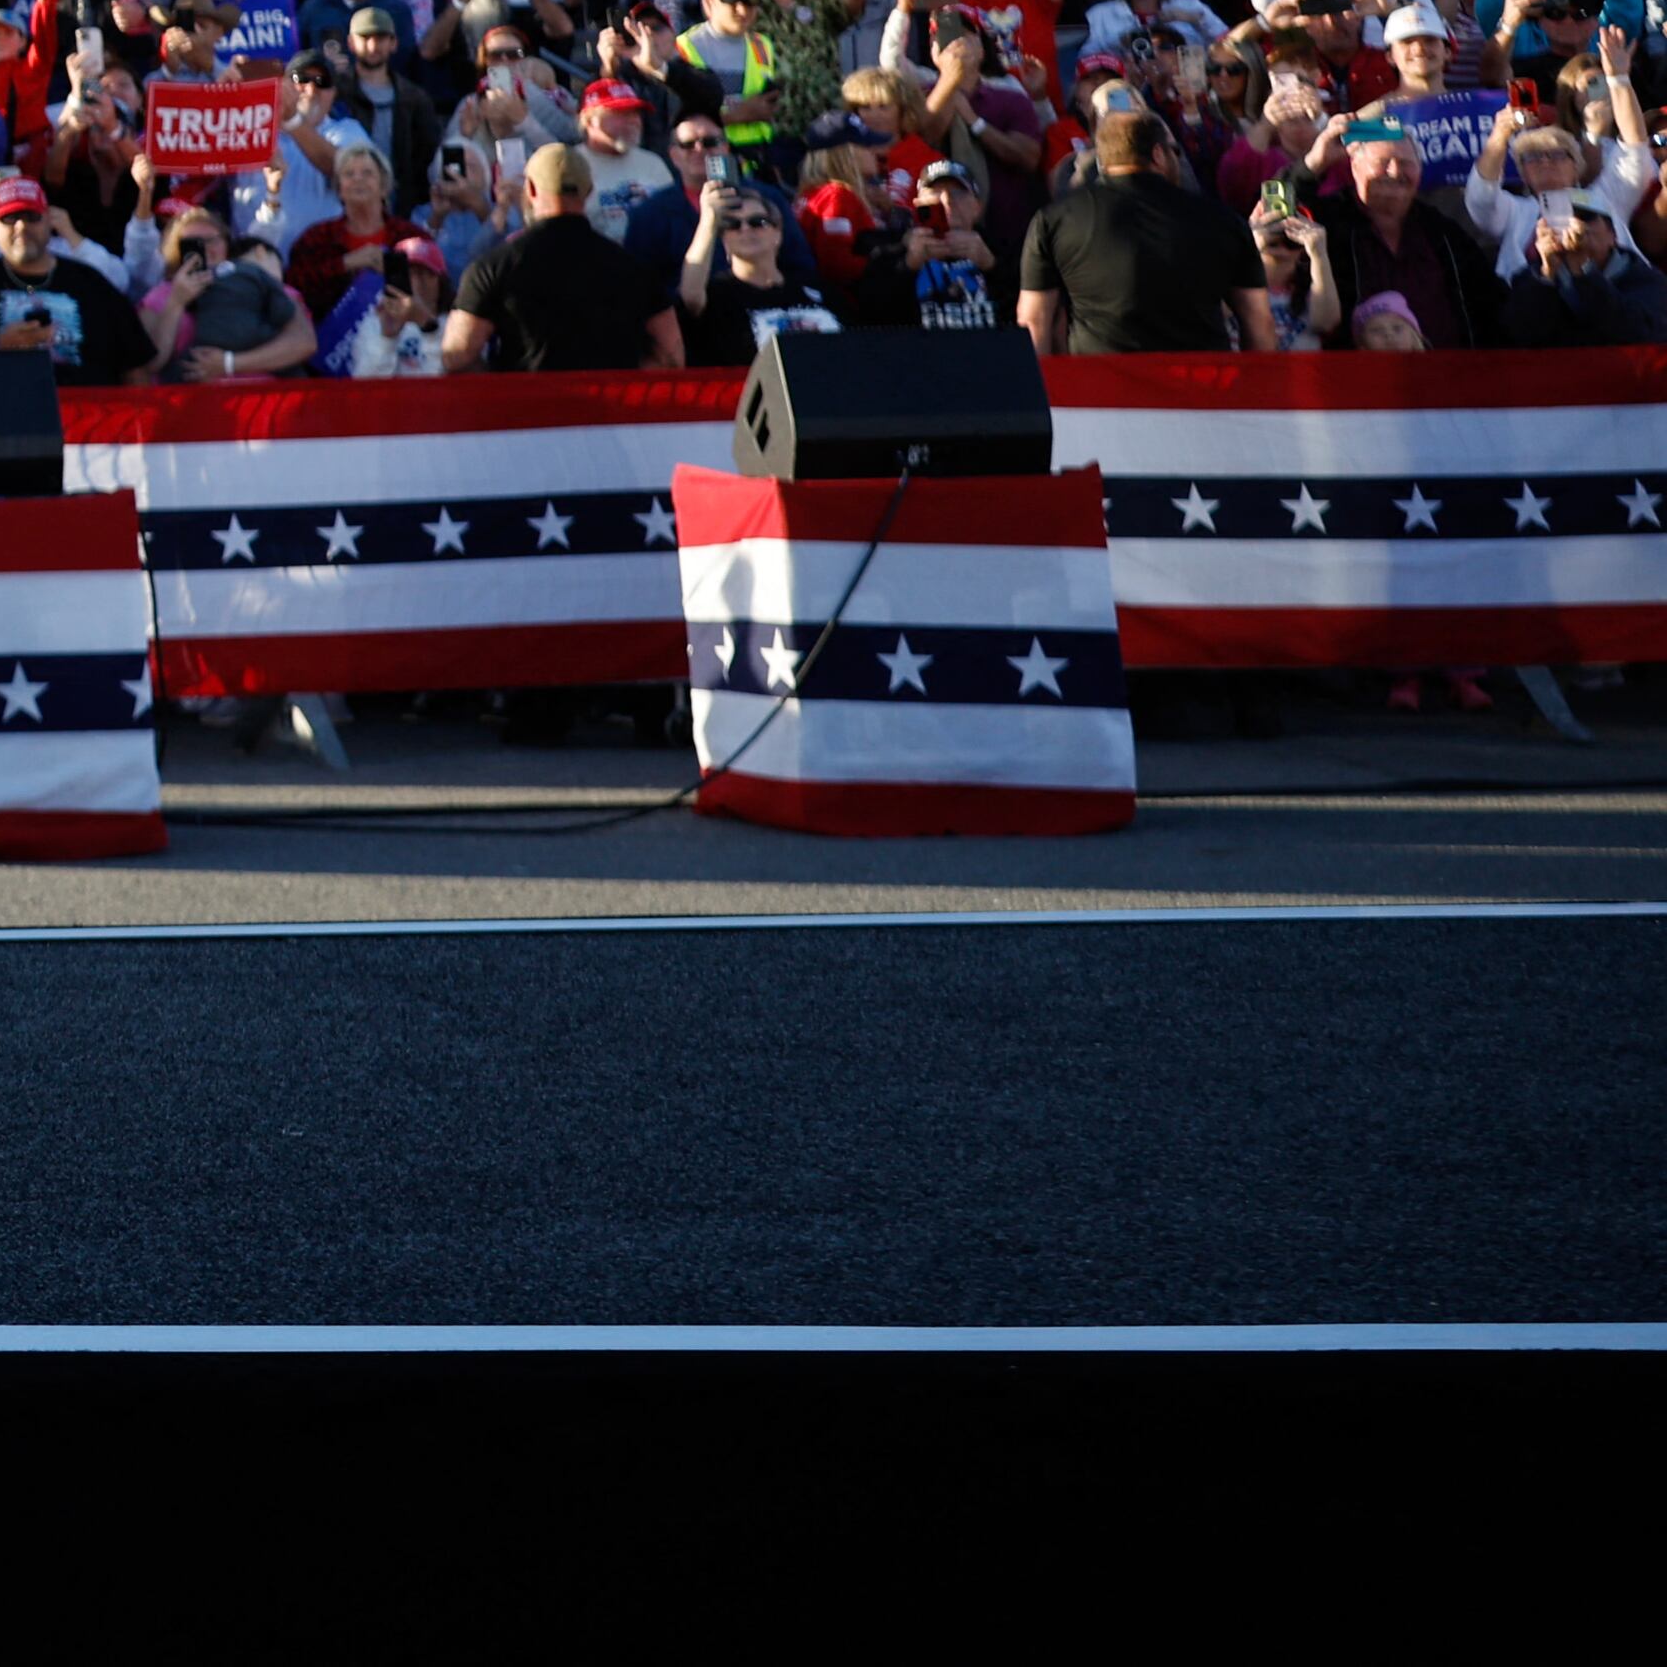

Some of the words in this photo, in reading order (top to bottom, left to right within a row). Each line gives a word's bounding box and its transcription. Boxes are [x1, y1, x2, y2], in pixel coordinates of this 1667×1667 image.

[252, 8, 291, 28] BIG,
[155, 103, 273, 135] TRUMP
[155, 131, 212, 153] WILL
[214, 130, 248, 151] FIX
[251, 127, 271, 149] IT
